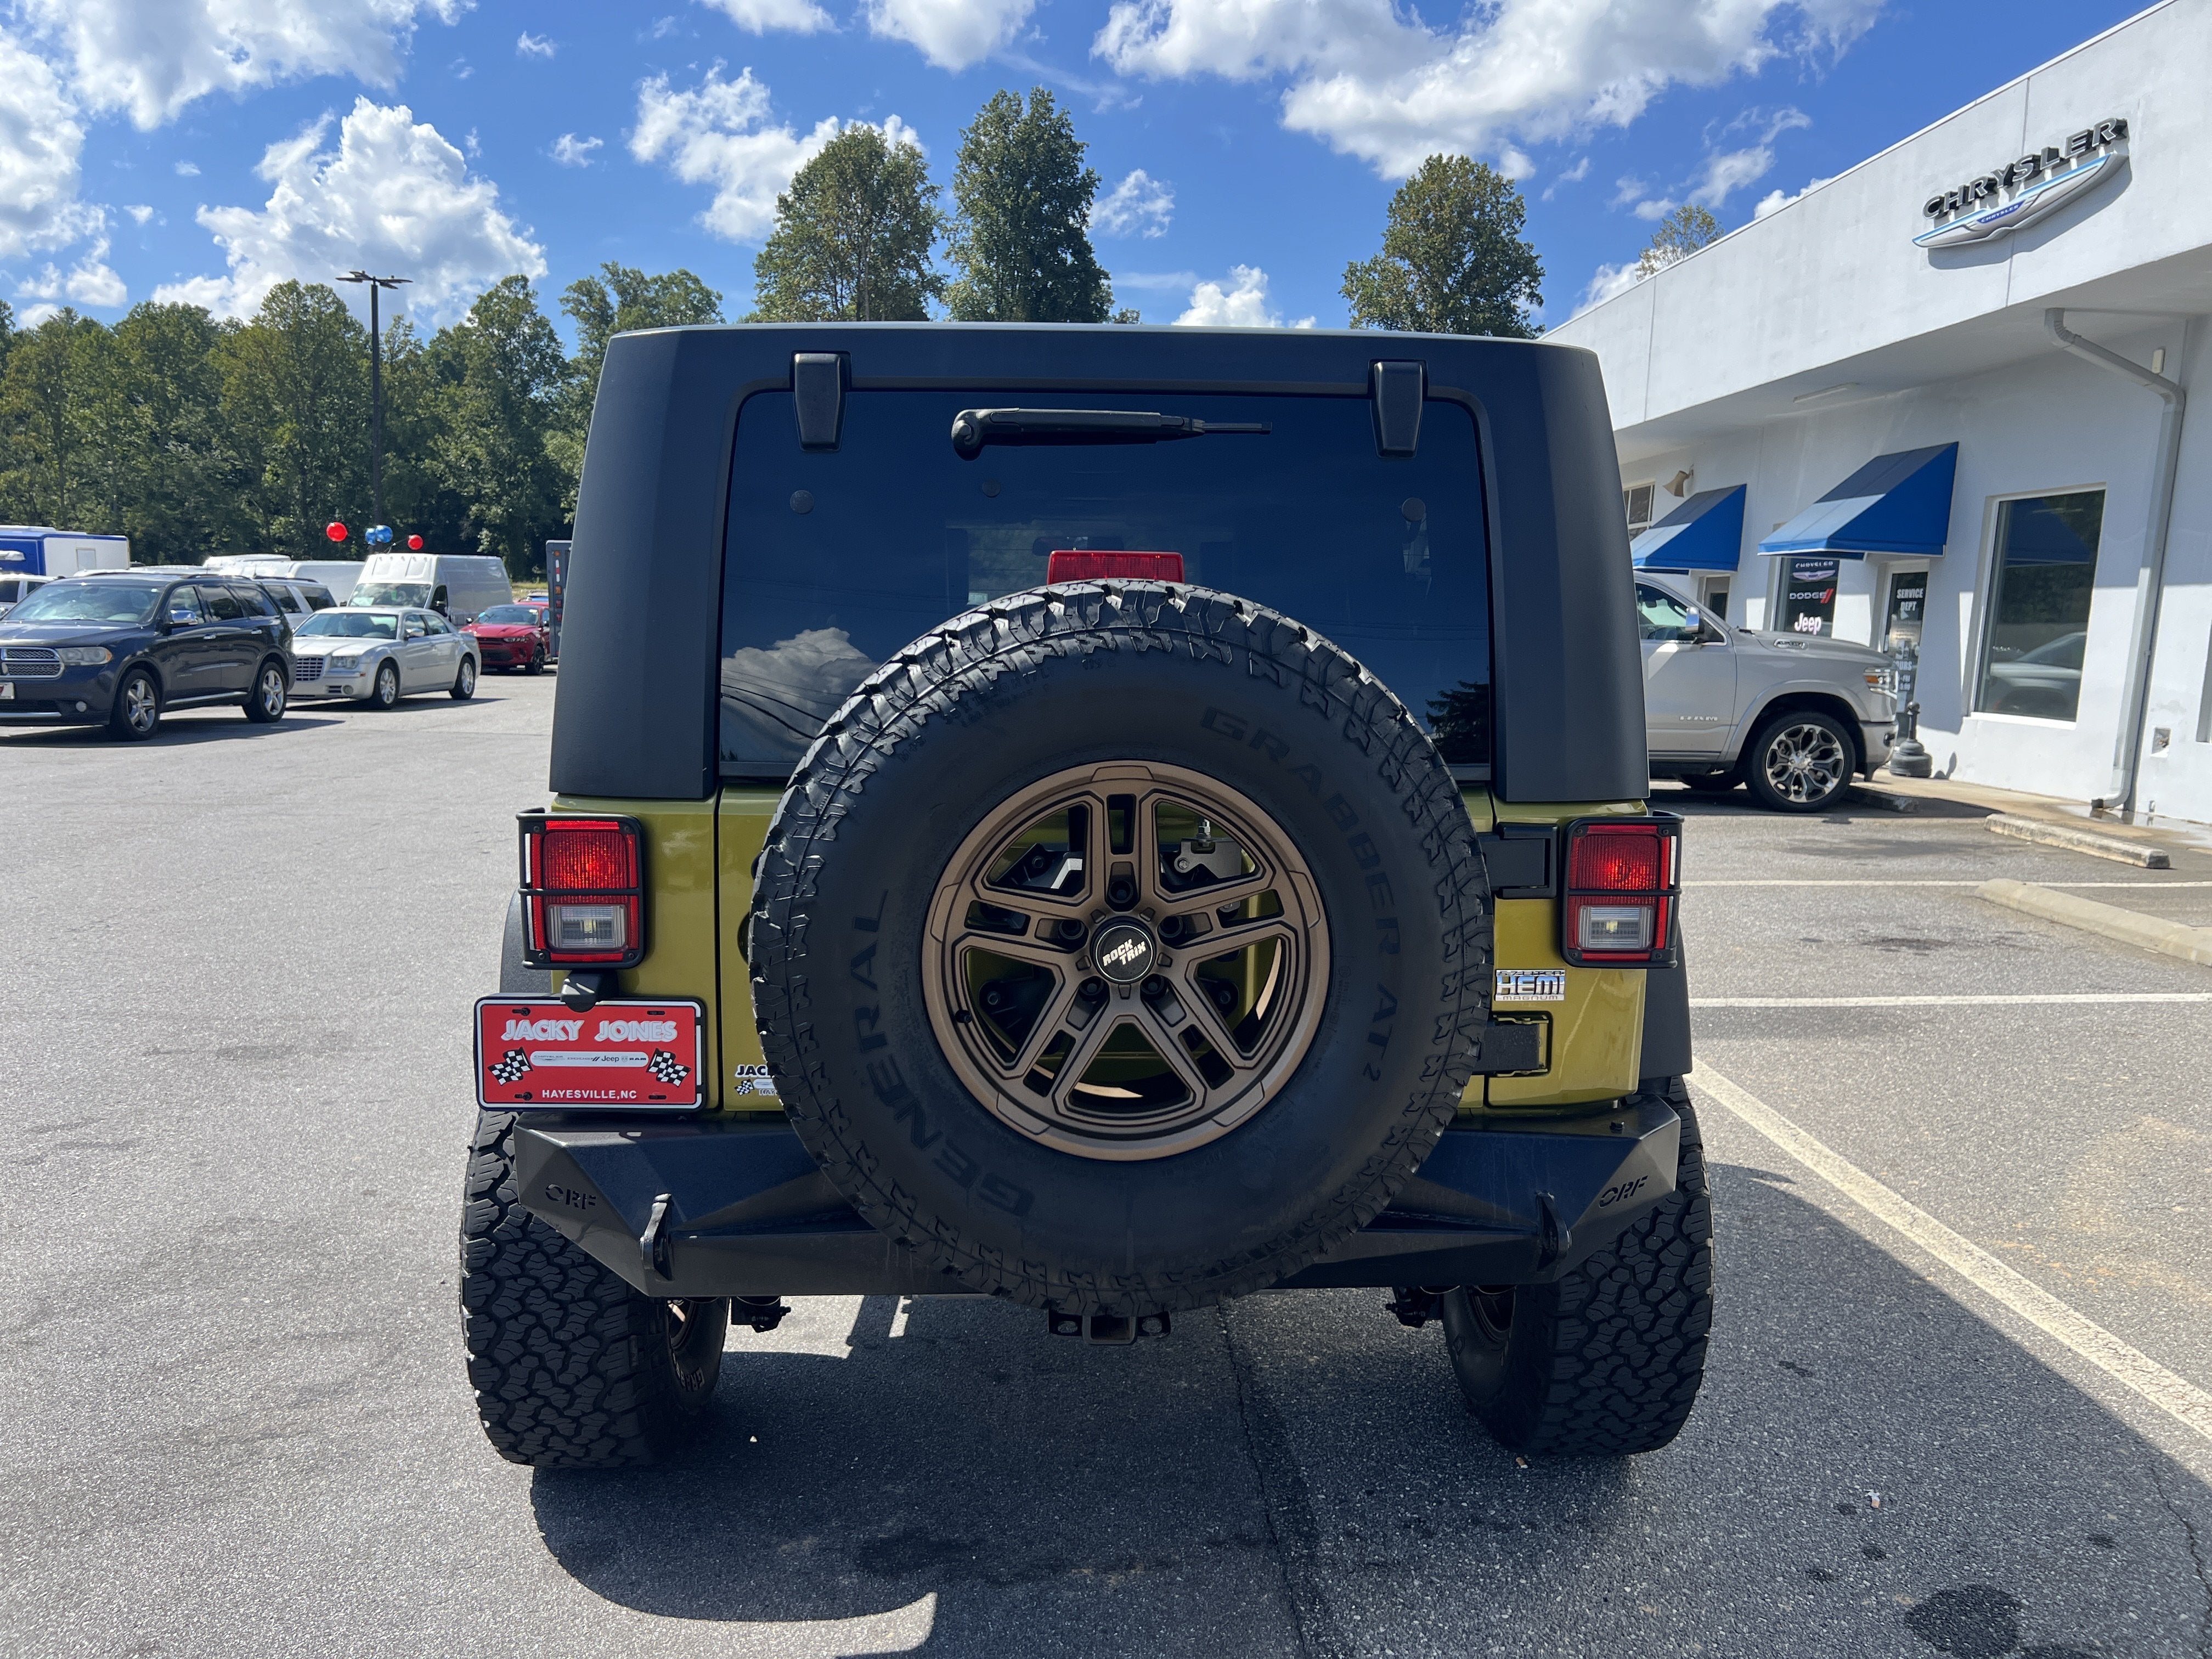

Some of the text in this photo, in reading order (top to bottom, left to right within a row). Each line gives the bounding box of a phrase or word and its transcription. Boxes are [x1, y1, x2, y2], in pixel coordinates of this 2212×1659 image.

[1923, 117, 2122, 219] CHRYSLER
[1980, 204, 2019, 223] CHRYSLER
[1897, 588, 1923, 599] SERVICE
[1900, 601, 1917, 612] DEPT
[1794, 613, 1822, 635] Jeep
[1200, 707, 1400, 955] GRABBER
[1102, 938, 1133, 967] ROCK
[1497, 976, 1565, 995] HEMI
[501, 1019, 678, 1042] JACKY JONES
[849, 889, 1035, 1217] GENERAL
[735, 1064, 770, 1078] JAC
[542, 1090, 637, 1100] HAYESVILLE,NC
